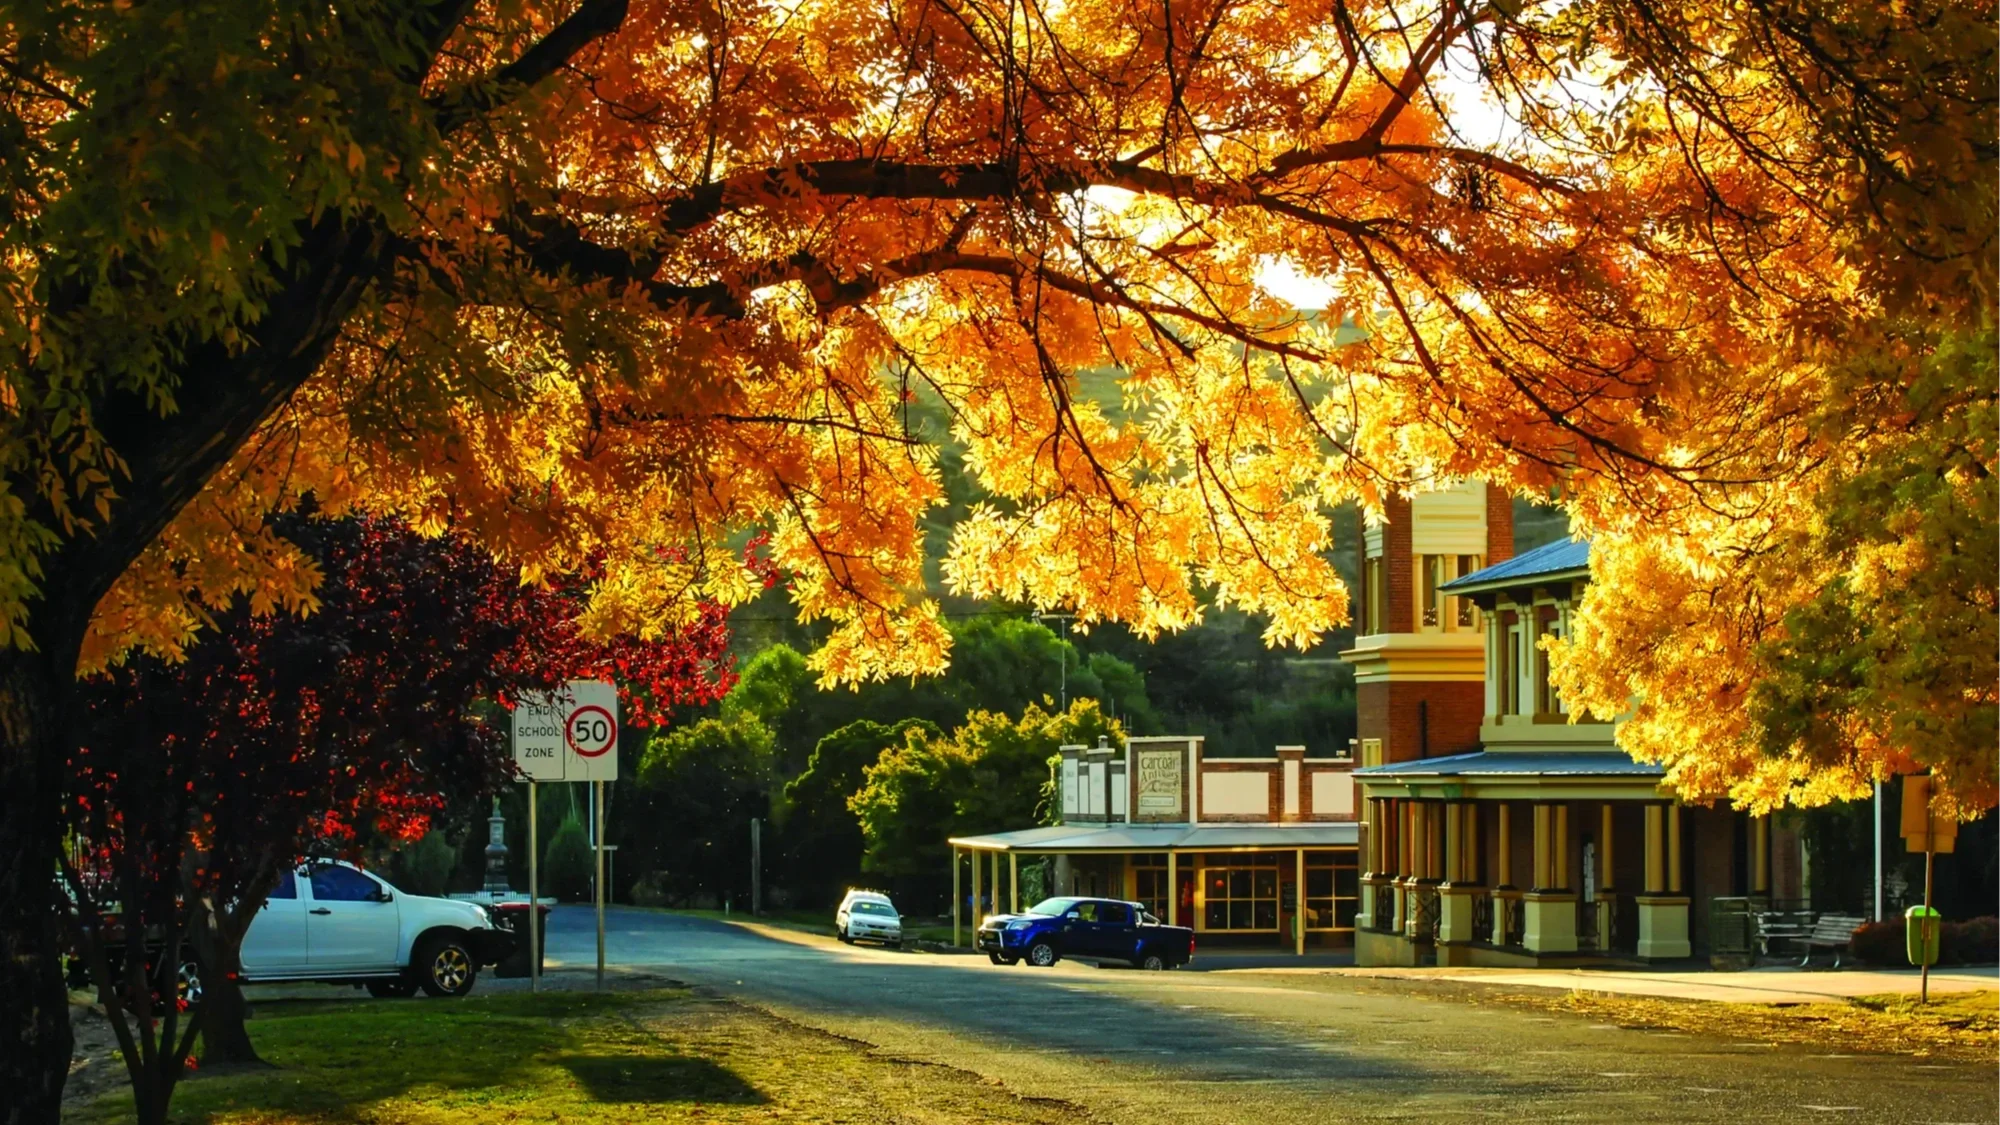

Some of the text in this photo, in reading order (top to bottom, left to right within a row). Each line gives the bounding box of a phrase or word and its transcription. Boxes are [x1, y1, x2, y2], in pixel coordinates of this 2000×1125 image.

[528, 706, 550, 716] END
[518, 727, 561, 737] SCHOOL
[576, 720, 608, 743] 50
[525, 748, 554, 758] ZONE
